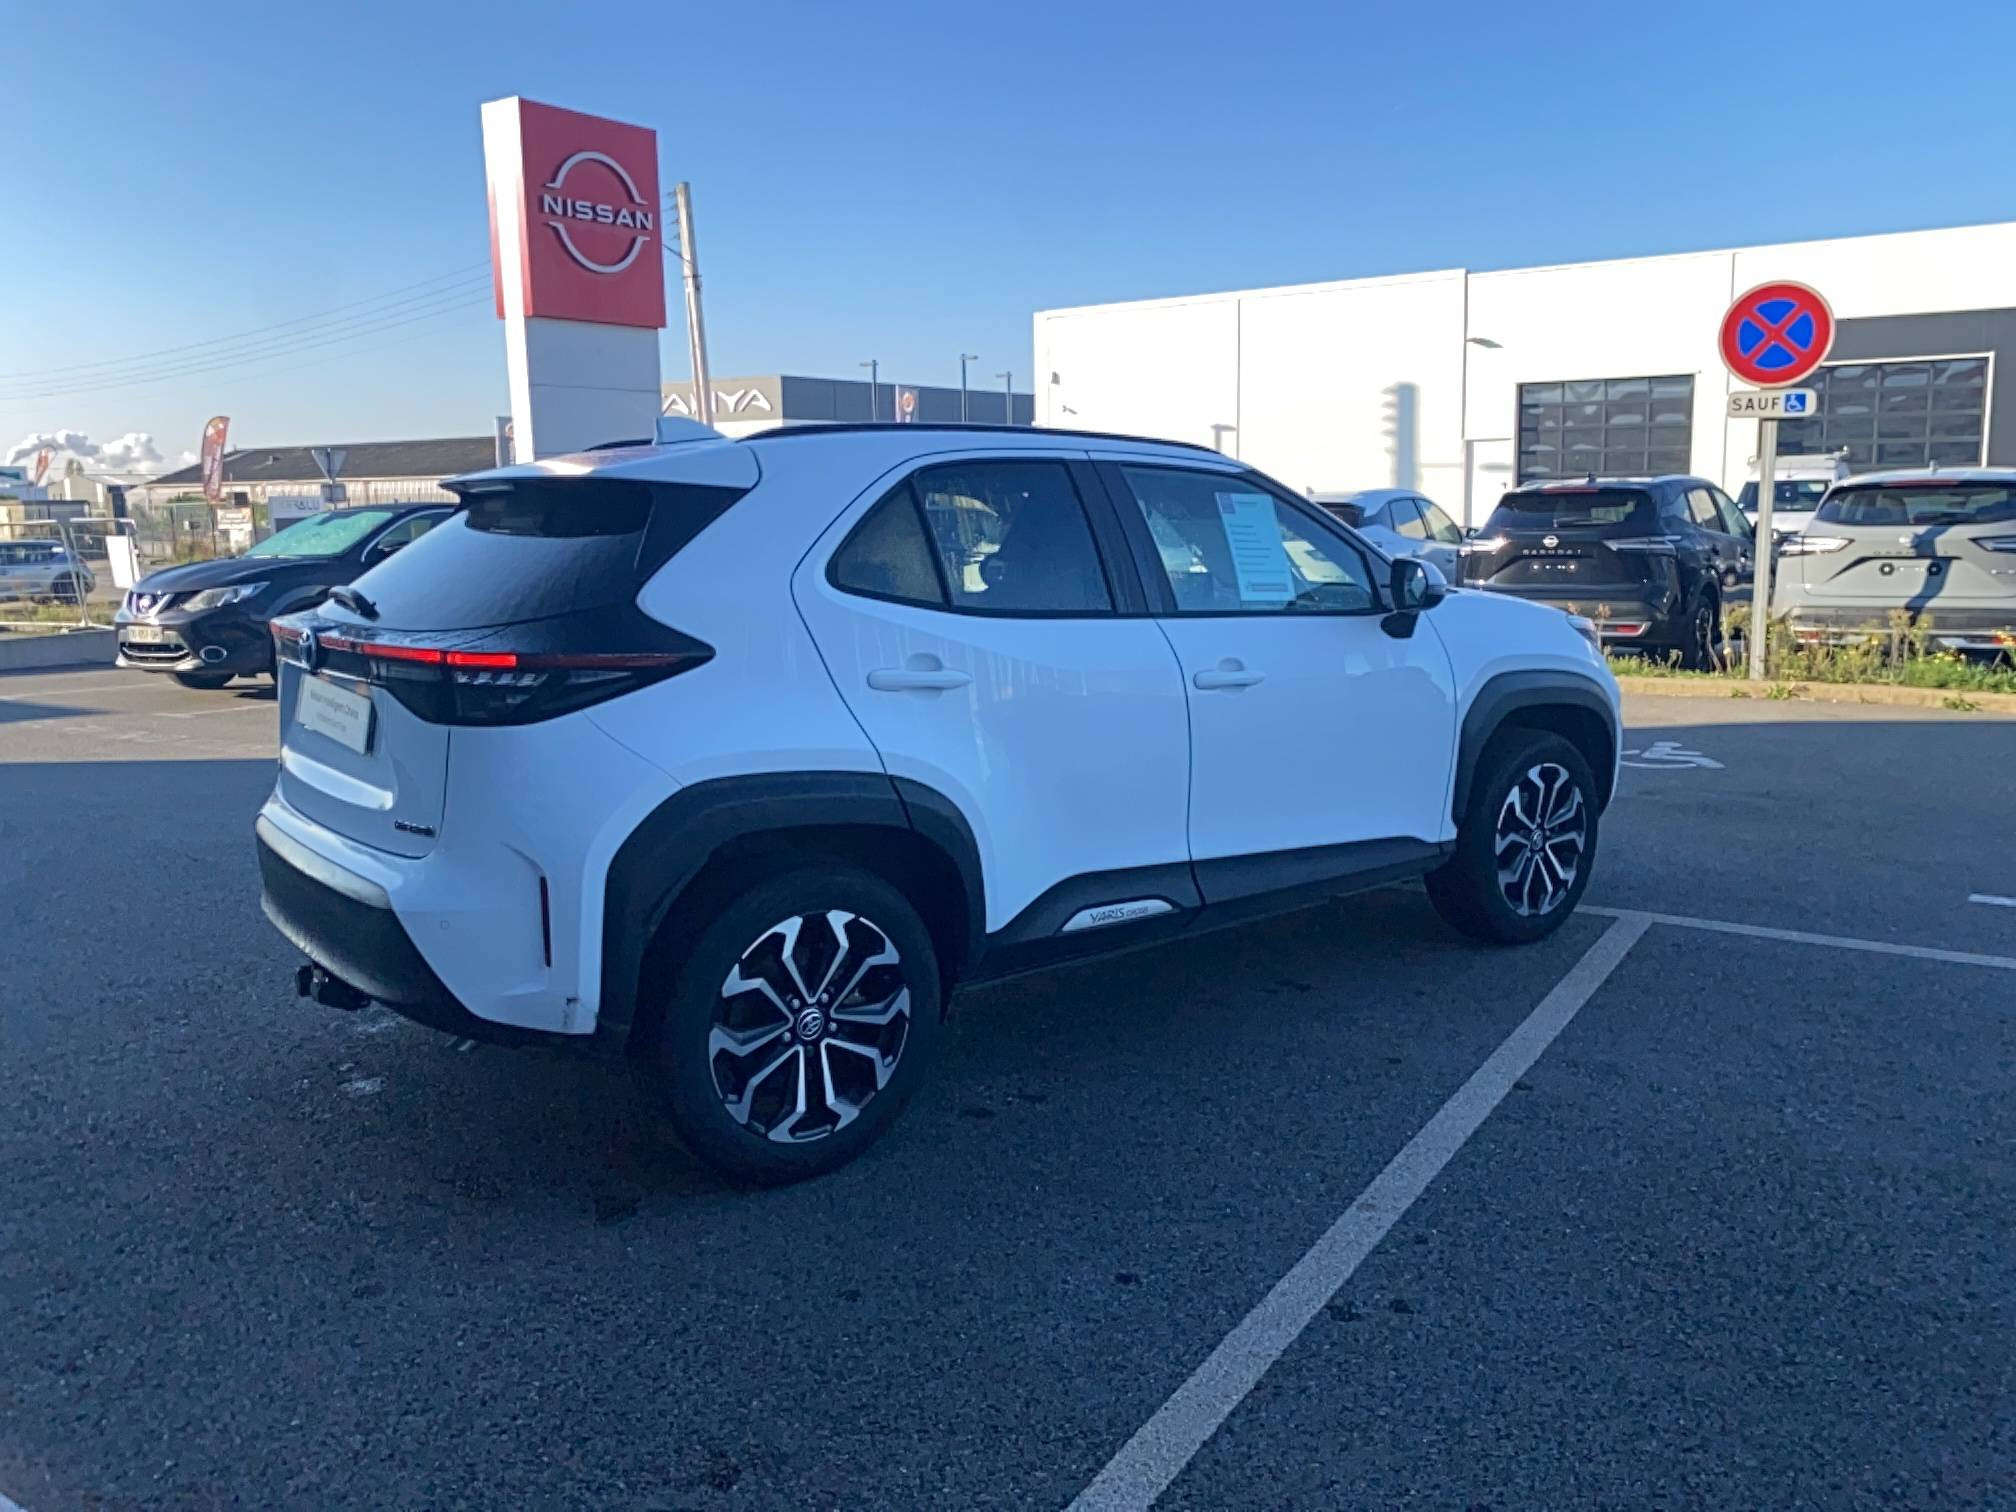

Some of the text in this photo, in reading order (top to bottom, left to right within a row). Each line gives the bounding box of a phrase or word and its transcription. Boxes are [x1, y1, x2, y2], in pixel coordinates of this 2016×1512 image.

[543, 193, 653, 231] NISSAN
[1731, 397, 1781, 411] SAUF
[1089, 907, 1126, 924] YARIS
